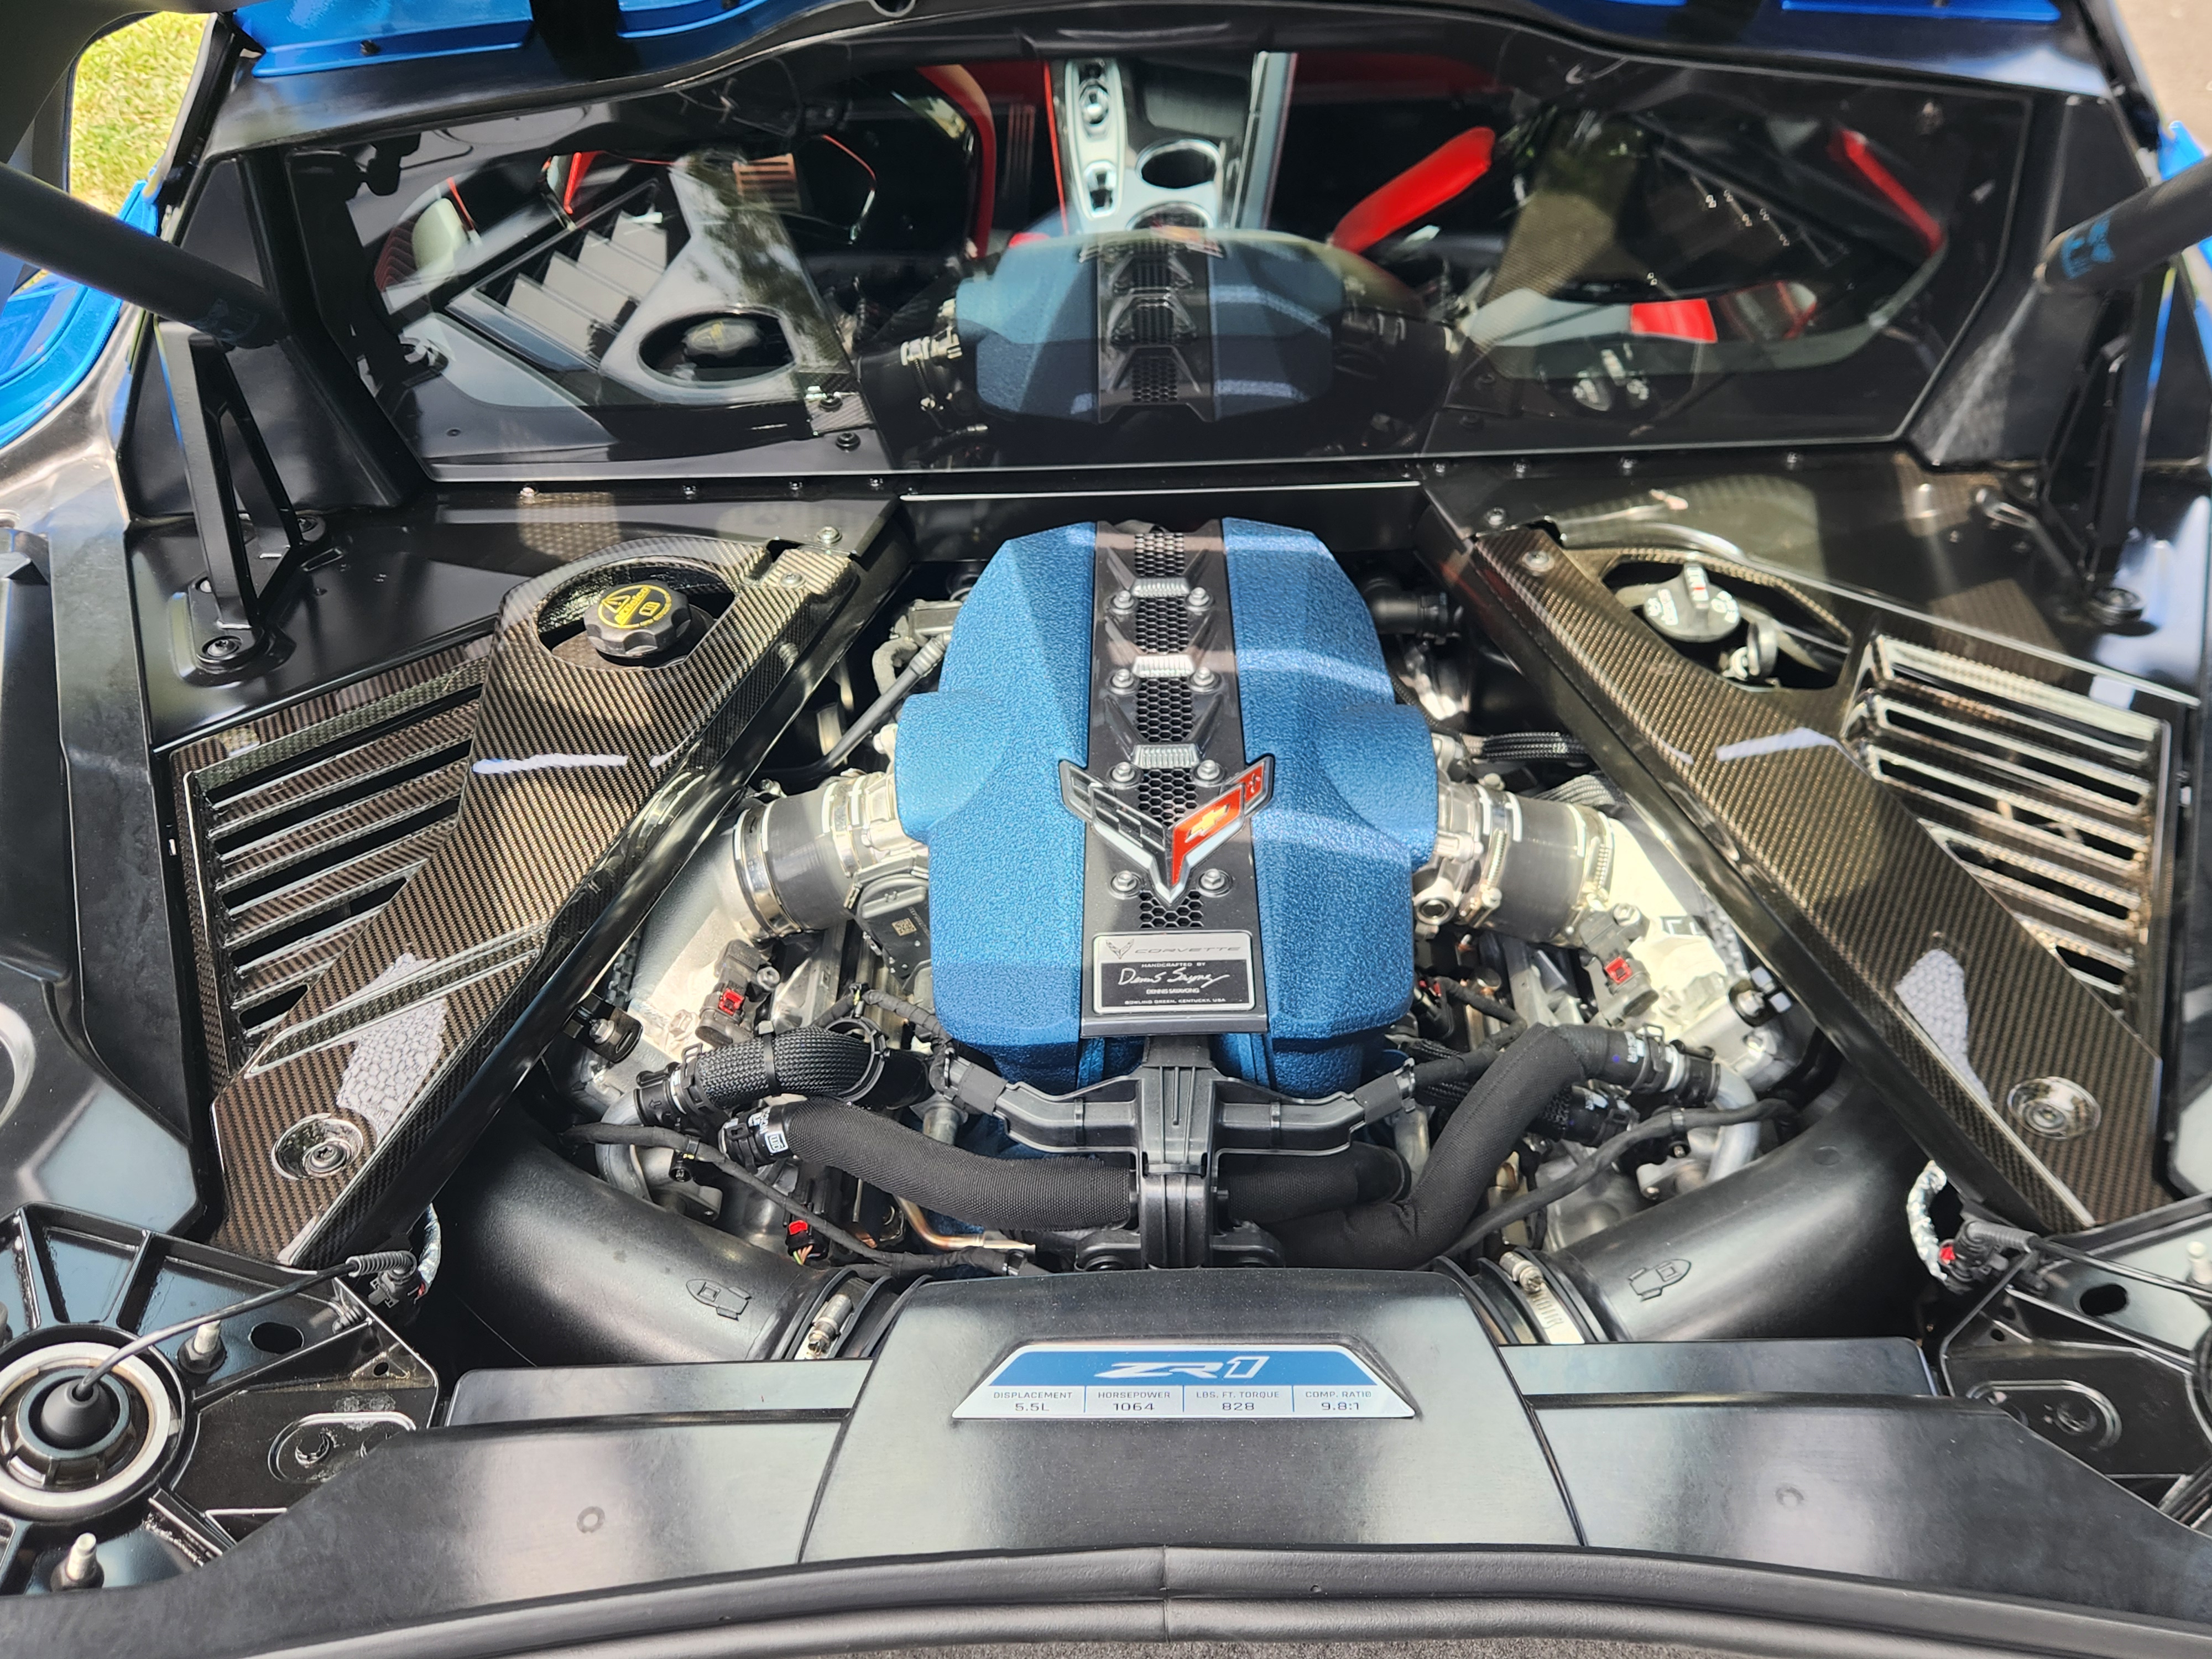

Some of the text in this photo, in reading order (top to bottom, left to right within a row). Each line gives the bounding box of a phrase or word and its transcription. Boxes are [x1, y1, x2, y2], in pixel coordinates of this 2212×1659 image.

[1094, 1355, 1270, 1378] ZR1
[1015, 1402, 1050, 1411] 5.5L
[1112, 1402, 1155, 1411] 1064
[1222, 1402, 1255, 1411] 828
[1321, 1402, 1359, 1411] 9.8:1
